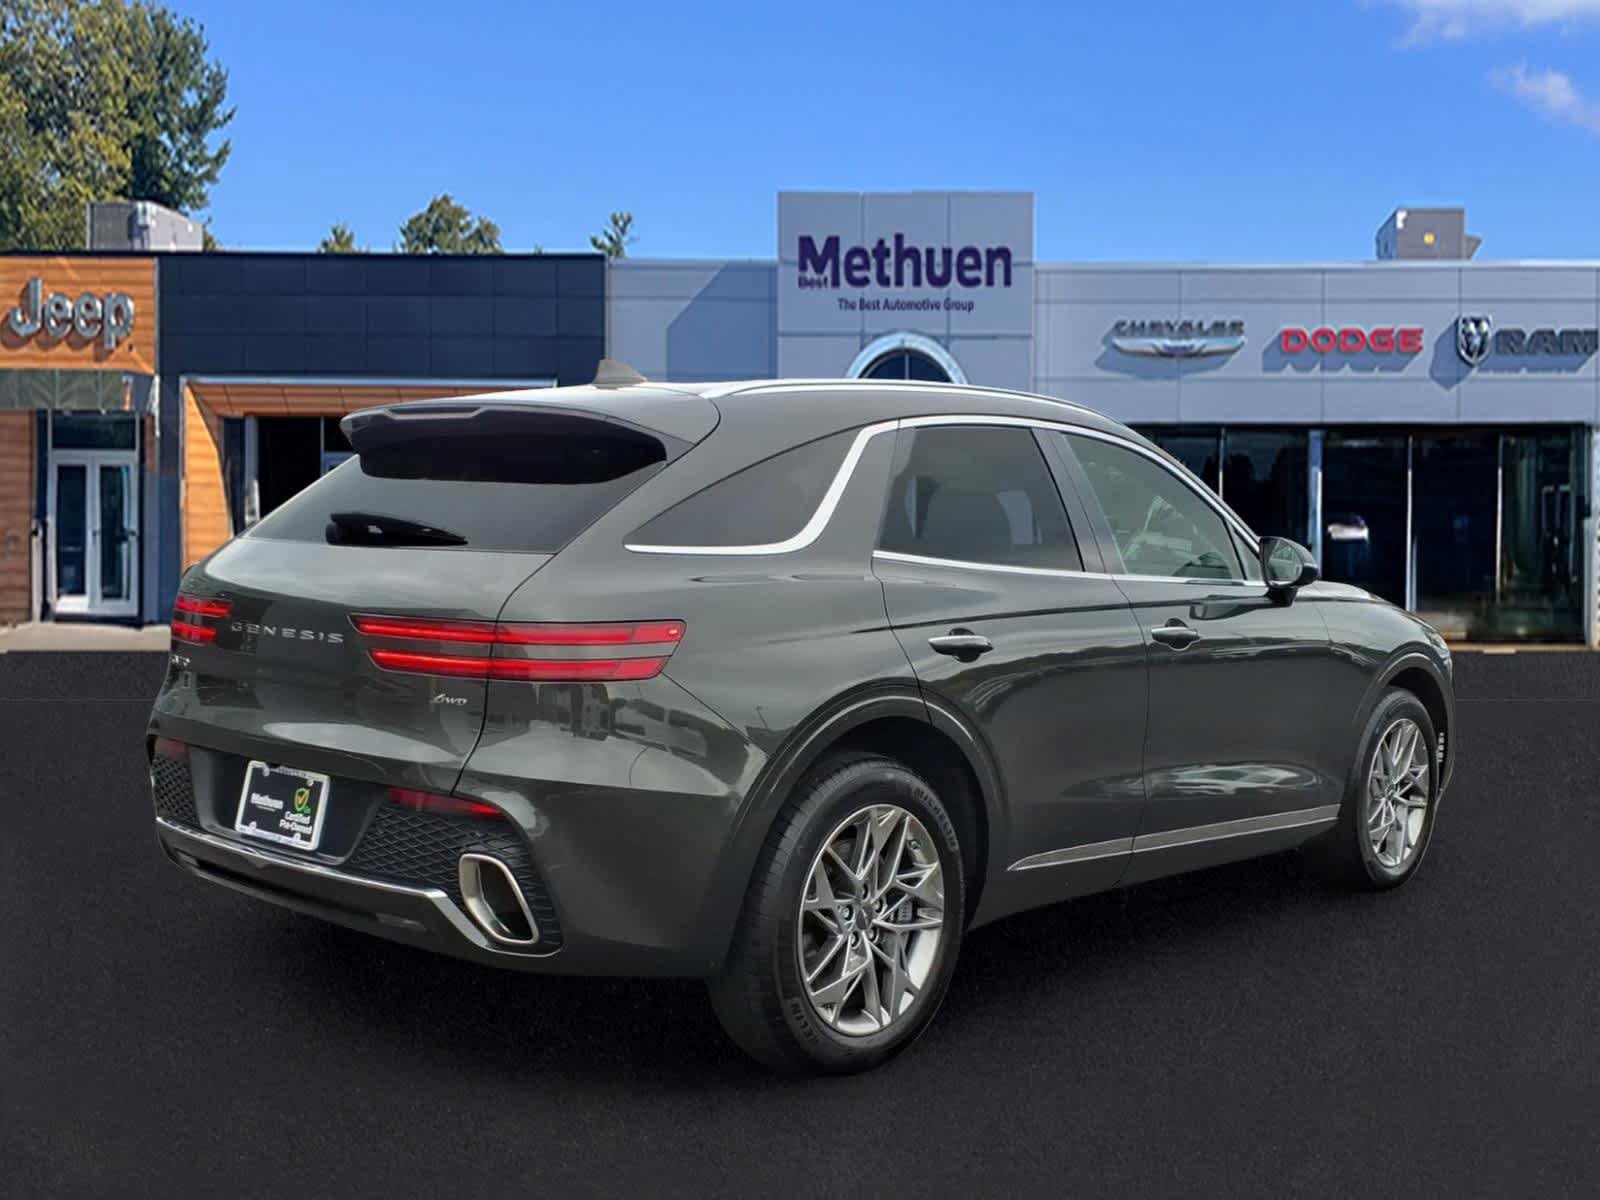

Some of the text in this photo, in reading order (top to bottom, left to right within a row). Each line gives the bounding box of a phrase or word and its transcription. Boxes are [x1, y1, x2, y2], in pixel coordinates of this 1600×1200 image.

[798, 233, 1012, 288] Methuen
[10, 277, 135, 349] Jeep
[838, 298, 974, 313] The Best Automotive Group
[1114, 320, 1245, 336] CHRYSLER
[1281, 328, 1423, 353] DODGE
[1495, 330, 1598, 354] RAM
[231, 622, 344, 643] GENESIS
